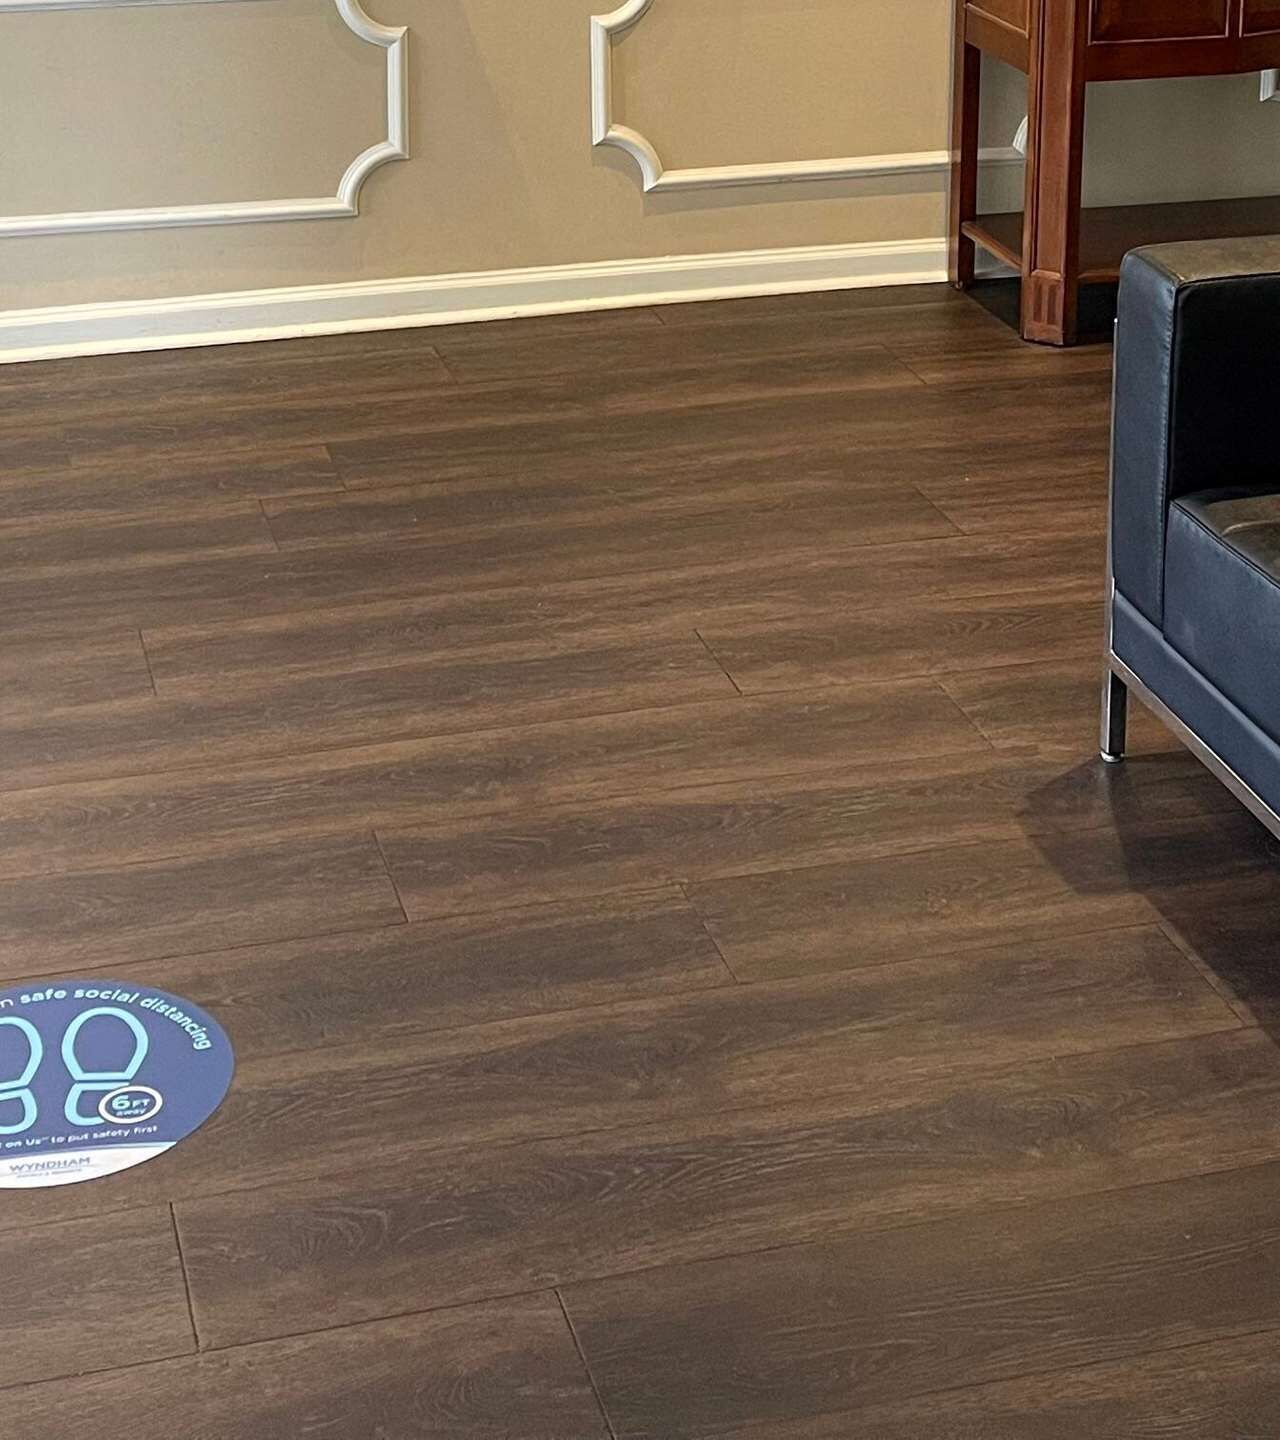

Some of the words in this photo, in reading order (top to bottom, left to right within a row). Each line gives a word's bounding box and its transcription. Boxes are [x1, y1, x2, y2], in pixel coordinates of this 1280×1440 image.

[19, 988, 67, 1005] safe
[74, 987, 137, 1005] social
[139, 996, 213, 1051] distancing
[116, 1107, 147, 1117] away
[5, 1140, 22, 1149] on
[25, 1136, 41, 1146] Us
[51, 1134, 65, 1144] to
[67, 1132, 89, 1143] put
[92, 1128, 131, 1139] safety
[133, 1124, 158, 1134] first
[9, 1156, 91, 1173] WYNDHAM
